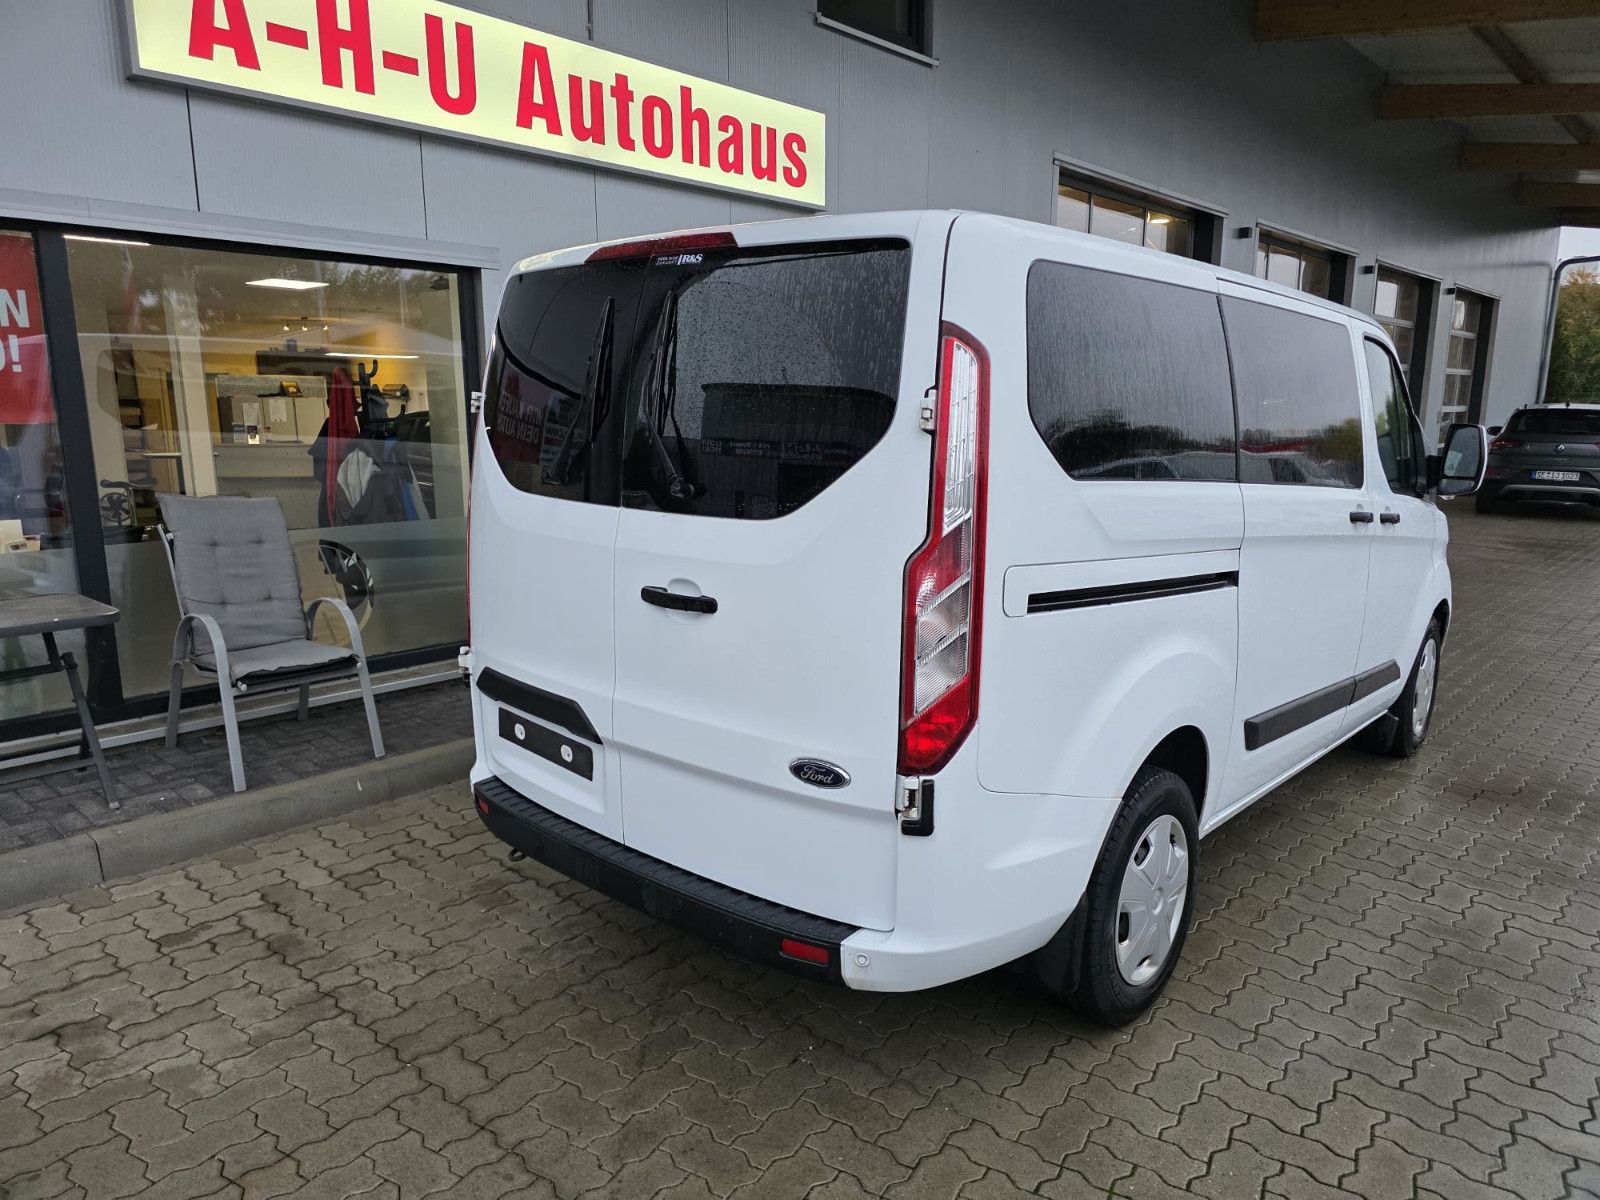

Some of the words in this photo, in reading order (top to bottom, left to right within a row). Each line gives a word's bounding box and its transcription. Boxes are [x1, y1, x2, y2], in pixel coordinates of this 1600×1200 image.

[188, 0, 477, 116] A-H-U
[516, 41, 807, 188] Autohaus
[800, 765, 833, 784] Ford
